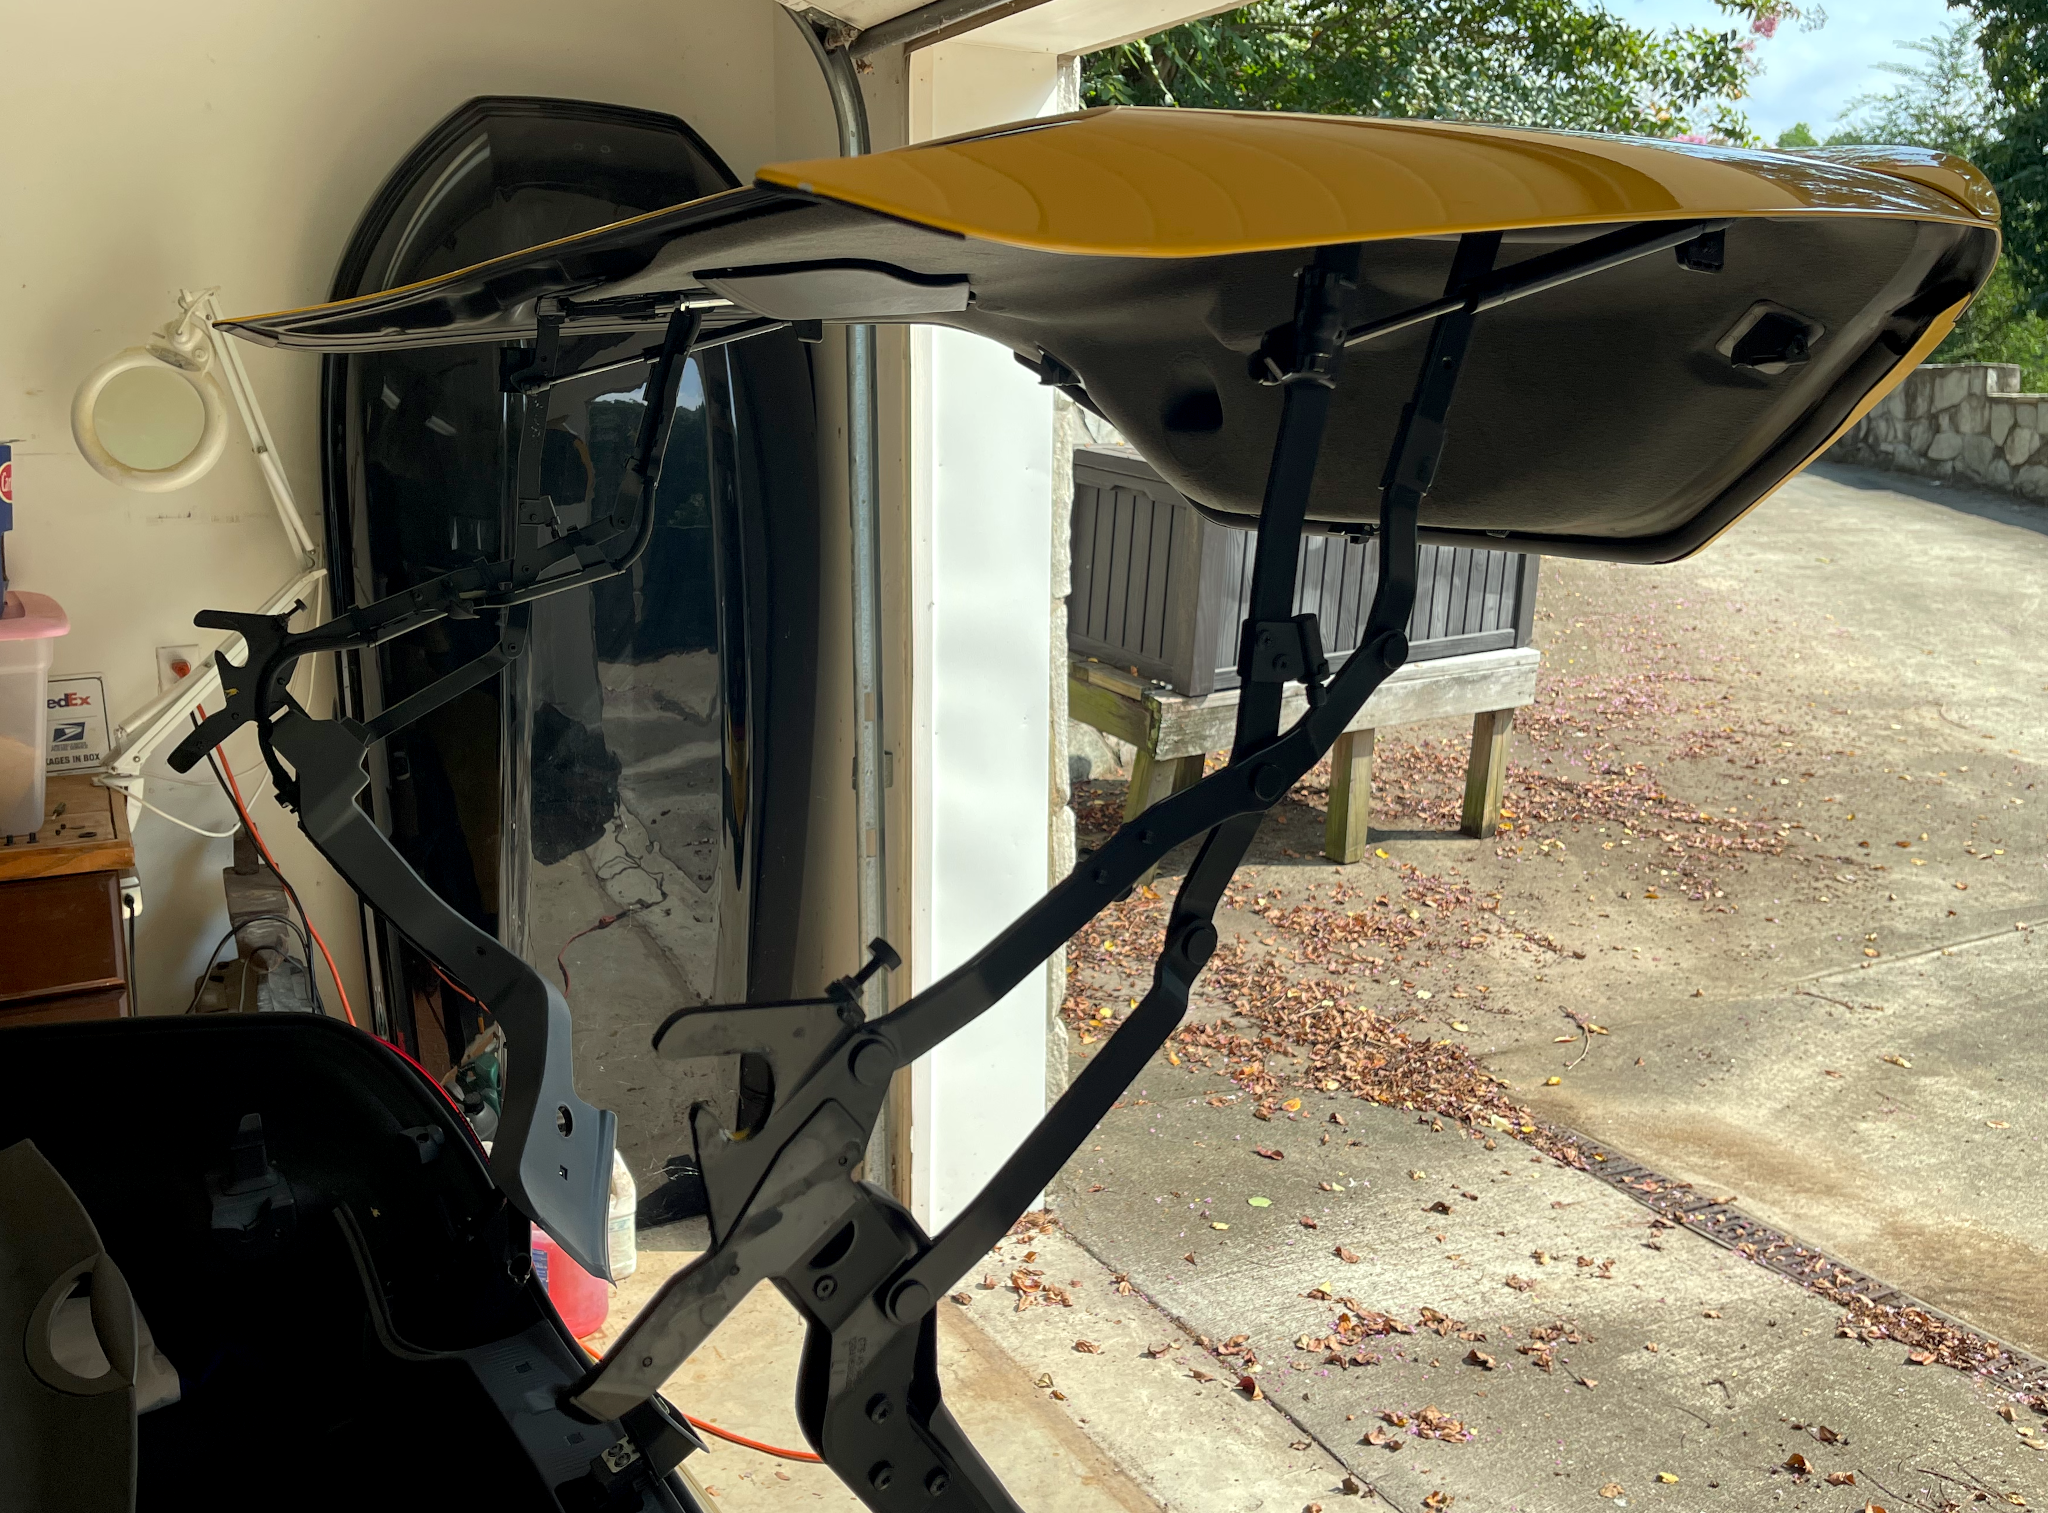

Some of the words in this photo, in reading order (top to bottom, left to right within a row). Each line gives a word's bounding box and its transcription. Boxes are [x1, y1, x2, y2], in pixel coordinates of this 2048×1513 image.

[47, 692, 91, 709] edEx
[72, 755, 82, 763] IN
[83, 753, 101, 761] BOX
